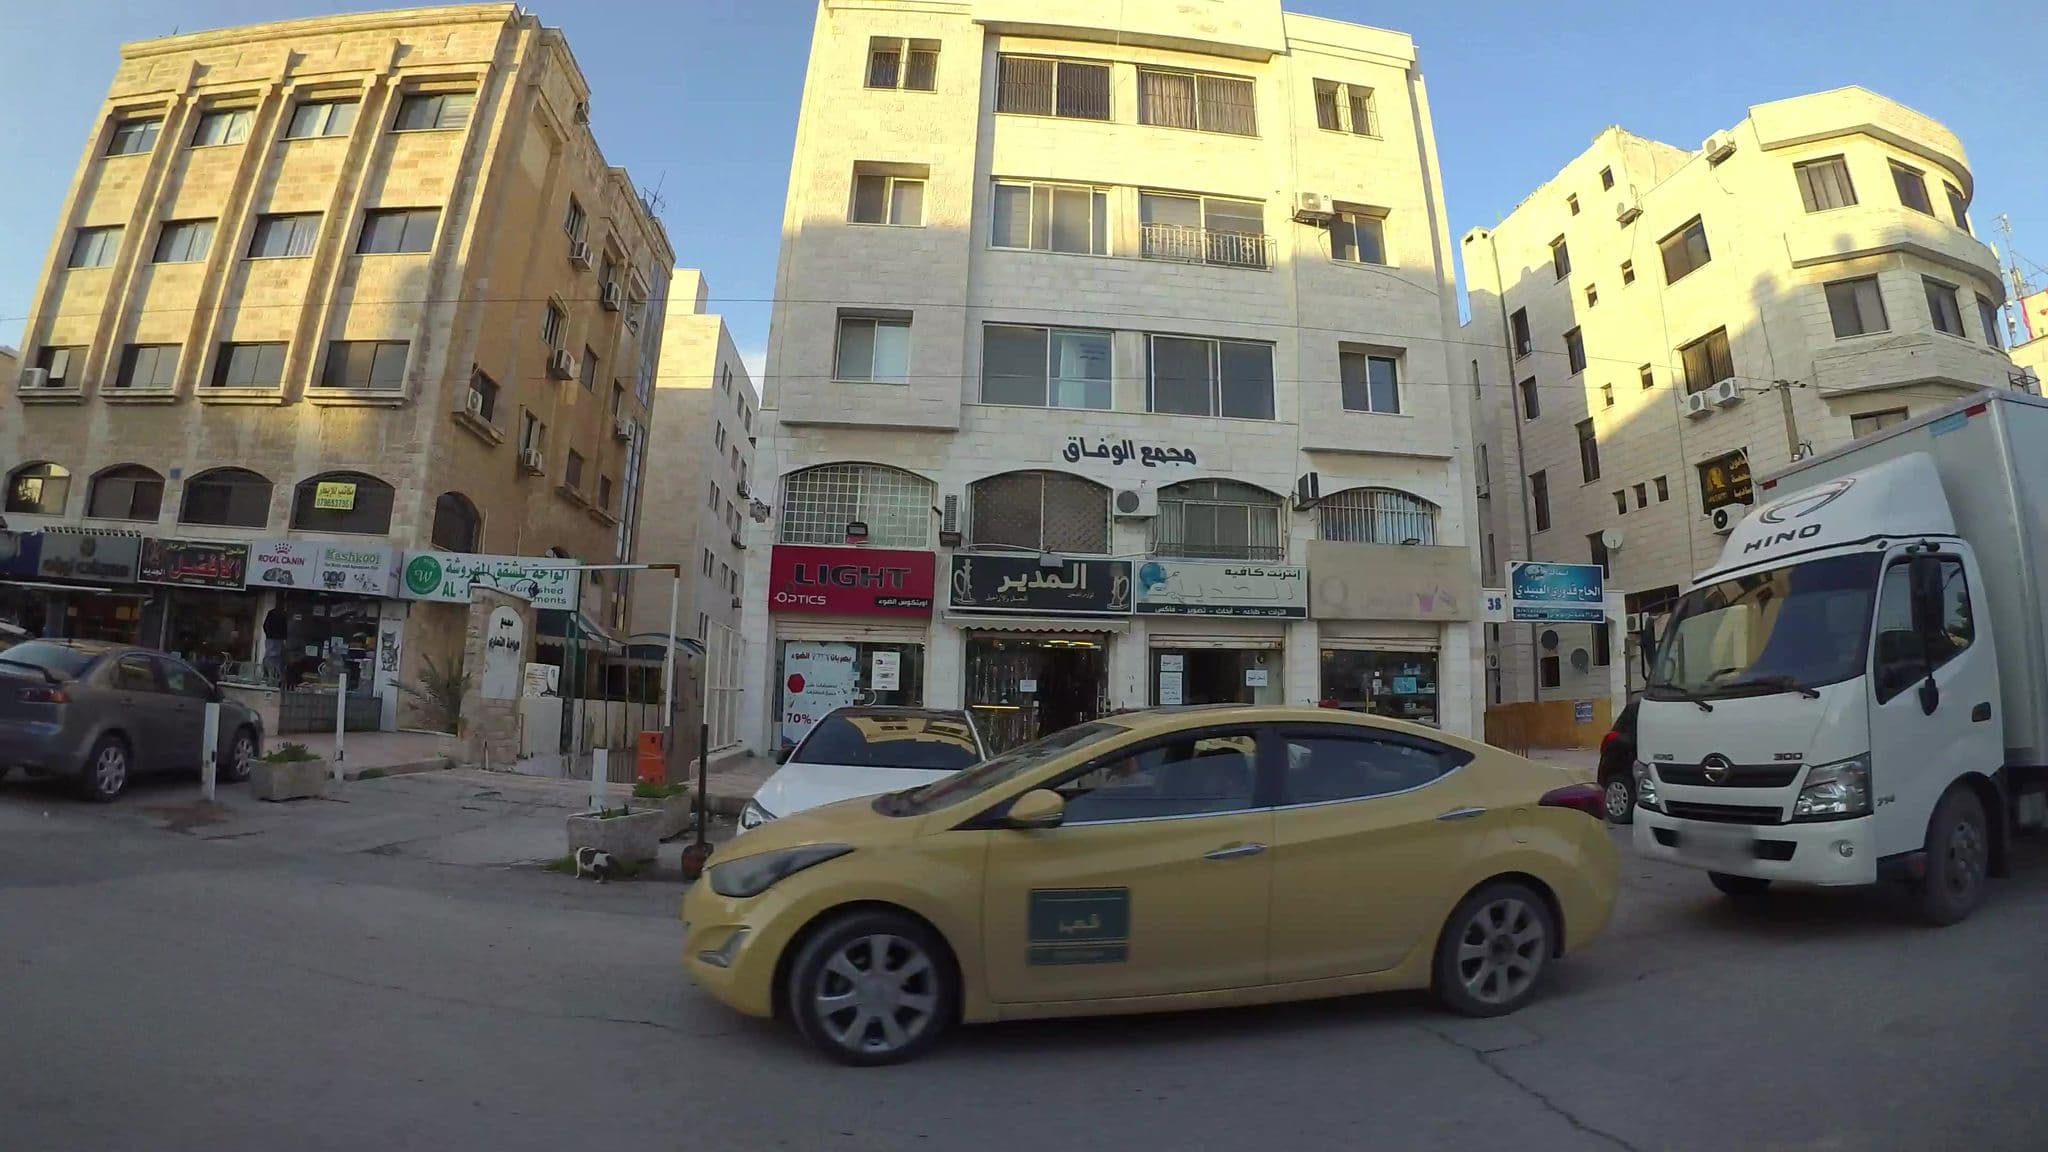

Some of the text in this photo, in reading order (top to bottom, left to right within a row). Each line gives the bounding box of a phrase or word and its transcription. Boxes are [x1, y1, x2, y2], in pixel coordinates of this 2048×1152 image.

[1062, 436, 1197, 467] مجمع الوفاق
[1744, 524, 1821, 553] HINO
[258, 554, 305, 566] ROYAL CANIN
[794, 563, 911, 589] LIGHT
[997, 562, 1087, 593] المدير
[1225, 567, 1264, 579] كافيه
[774, 592, 827, 605] OPTICS
[786, 713, 812, 724] 70%
[1773, 752, 1803, 760] 300
